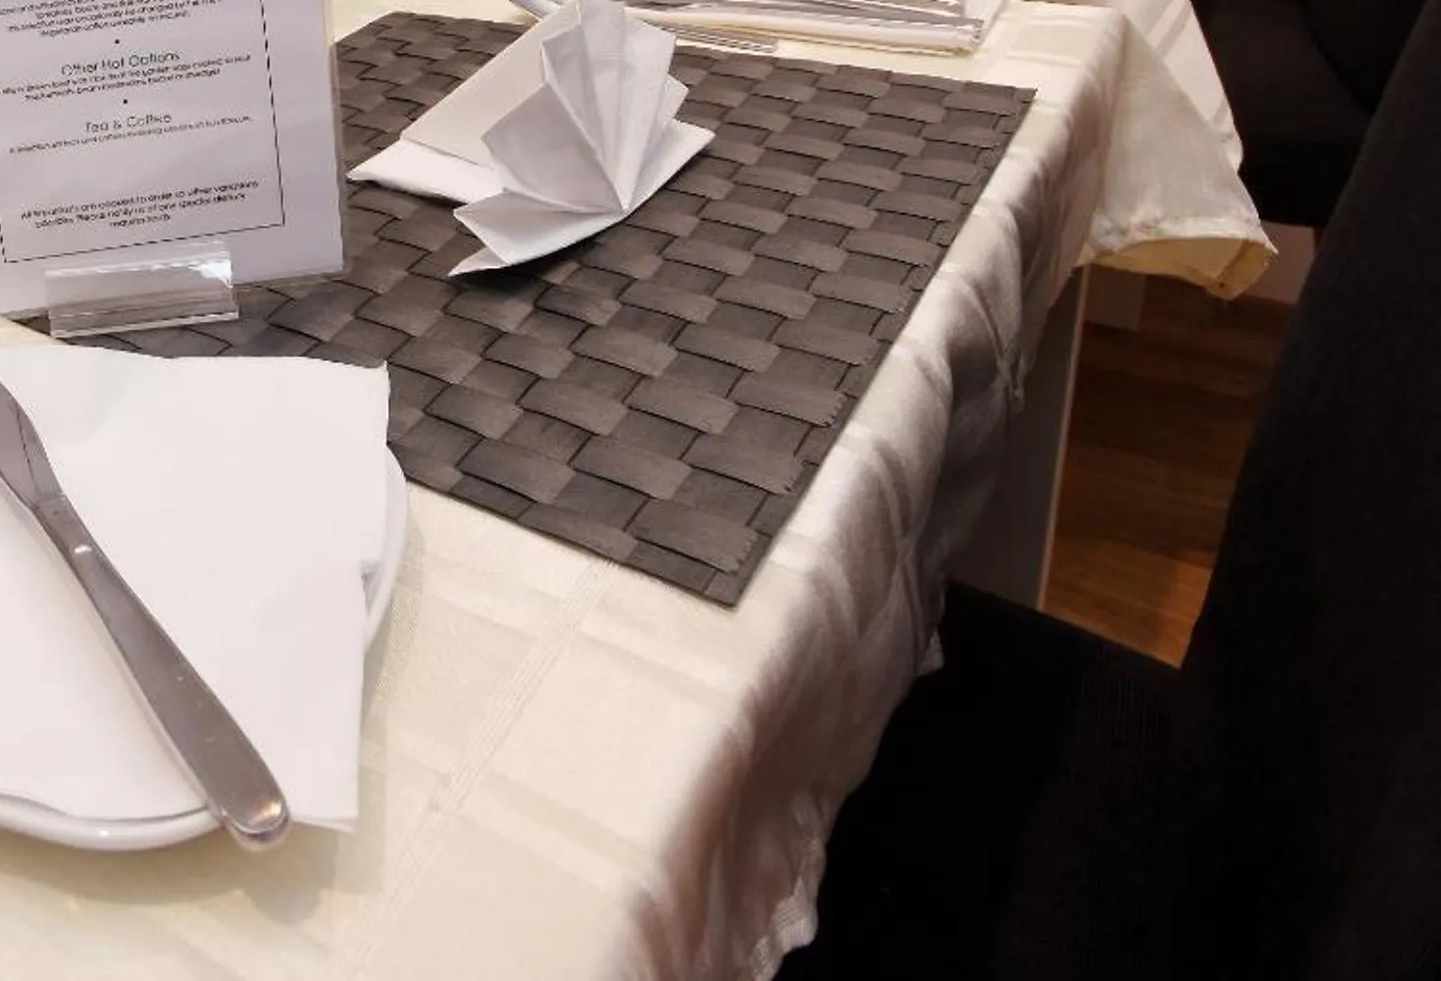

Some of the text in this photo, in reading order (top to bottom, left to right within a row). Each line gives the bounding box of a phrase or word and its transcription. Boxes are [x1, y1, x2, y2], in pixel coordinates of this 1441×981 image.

[61, 52, 181, 77] Other Hot Options
[85, 113, 173, 133] Tea & Coffee
